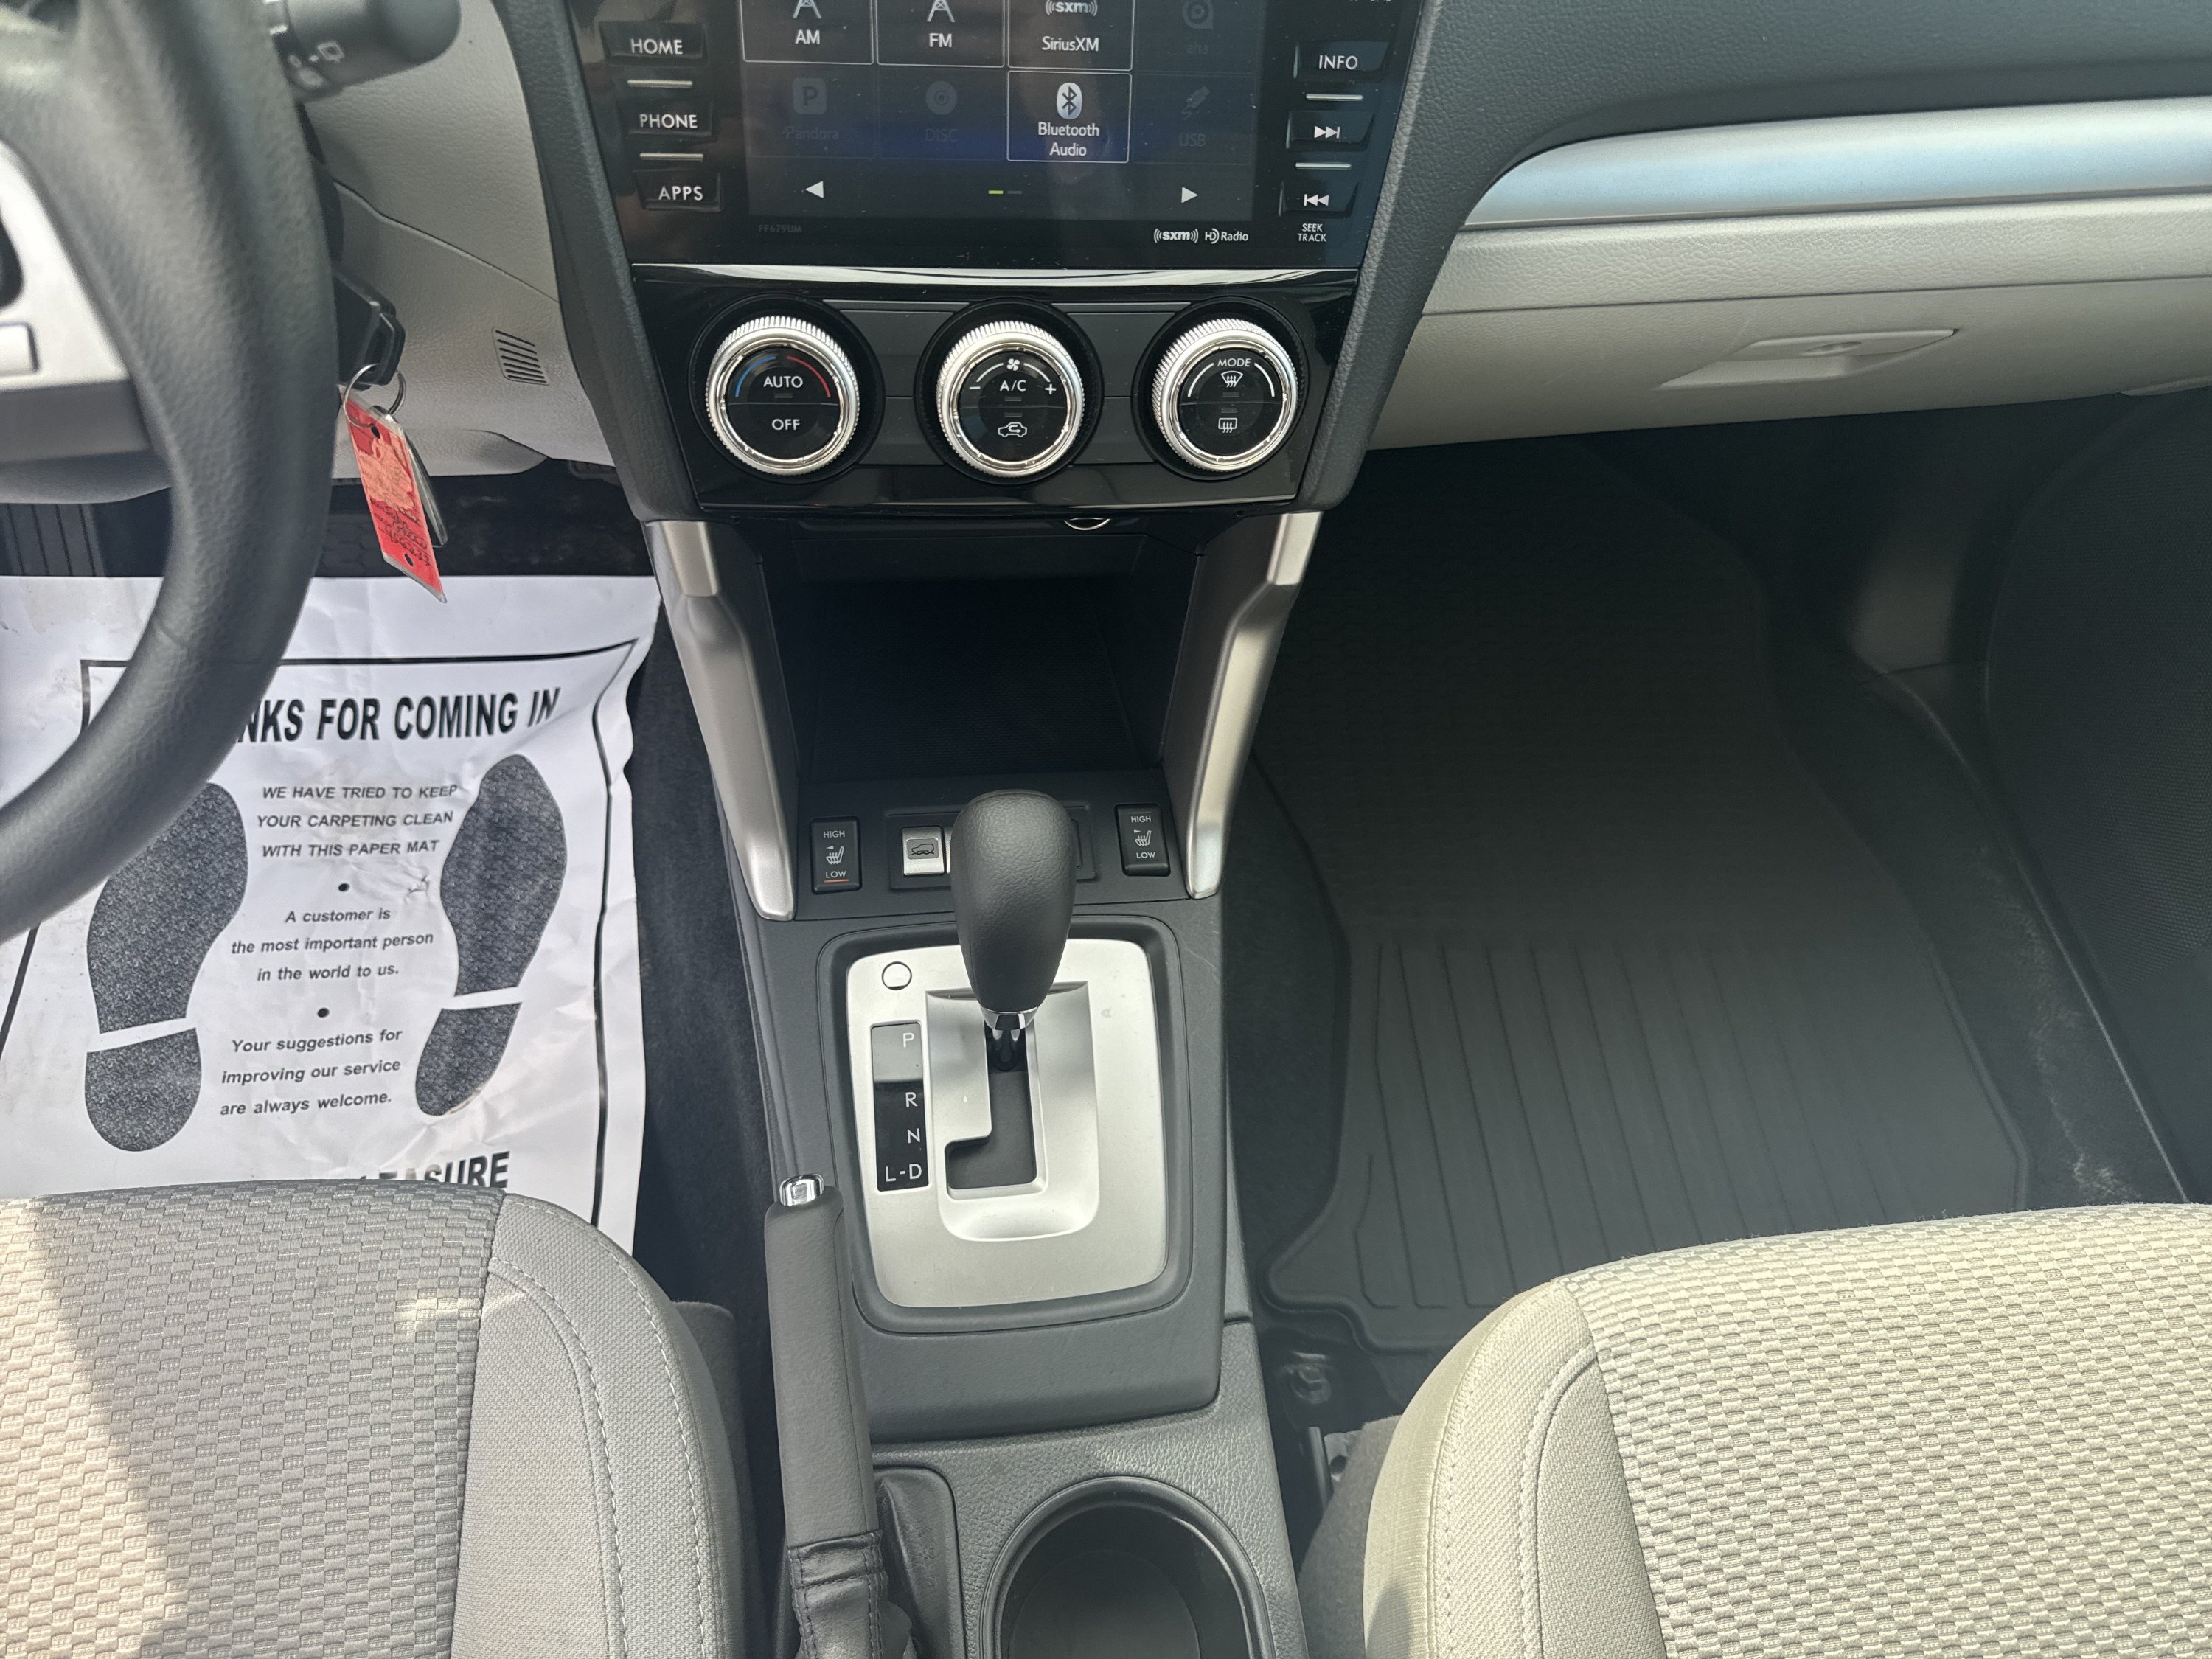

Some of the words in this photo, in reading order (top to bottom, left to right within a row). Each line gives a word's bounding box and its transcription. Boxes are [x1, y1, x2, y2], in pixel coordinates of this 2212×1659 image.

[795, 29, 820, 45] AM
[929, 32, 952, 48] FM
[1042, 35, 1099, 52] SiriusXM
[630, 38, 683, 55] HOME
[1318, 55, 1358, 70] INFO
[640, 114, 698, 129] PHONE
[1038, 121, 1099, 136] Bluetooth
[785, 126, 839, 141] Pandora
[925, 128, 959, 142] DISC
[1179, 133, 1206, 147] USB
[1049, 142, 1087, 156] Audio
[658, 185, 703, 201] APPS
[757, 224, 803, 234] FF679UM
[1301, 223, 1323, 232] SEEK
[1220, 230, 1249, 242] Radio
[1297, 233, 1327, 243] TRACK
[1217, 358, 1251, 367] MODE
[763, 375, 804, 389] AUTO
[999, 379, 1026, 392] A/C
[771, 418, 800, 431] OFF
[316, 698, 380, 740] FOR
[394, 692, 518, 740] COMING
[527, 687, 561, 727] IN
[262, 786, 287, 799] WE
[292, 787, 335, 799] HAVE
[342, 786, 386, 799] TRIED
[392, 787, 413, 799] TO
[418, 784, 459, 799] KEEP
[257, 815, 302, 828] YOUR
[307, 814, 397, 827] CARPETING
[402, 811, 453, 826] CLEAN
[823, 830, 846, 838] HIGH
[262, 844, 302, 858] WITH
[308, 844, 344, 857] THIS
[349, 843, 401, 855] PAPER
[406, 839, 440, 853] MAT
[825, 870, 846, 879] LOW
[285, 911, 296, 923] A
[302, 911, 374, 922] customer
[378, 908, 391, 919] is
[232, 940, 255, 954] the
[260, 939, 299, 953] most
[305, 936, 378, 953] important
[382, 933, 434, 950] person
[257, 968, 271, 981] in
[278, 967, 302, 981] the
[309, 964, 351, 979] world
[357, 966, 372, 978] to
[378, 964, 399, 976] us.
[232, 1040, 271, 1053] Your
[276, 1033, 373, 1053] suggestions
[380, 1029, 403, 1042] for
[902, 1032, 915, 1048] P
[221, 1068, 305, 1086] improving
[310, 1066, 338, 1078] our
[344, 1060, 401, 1076] service
[220, 1104, 246, 1116] are
[253, 1099, 310, 1114] always
[317, 1093, 392, 1109] welcome.
[905, 1091, 918, 1107] R
[907, 1127, 921, 1144] N
